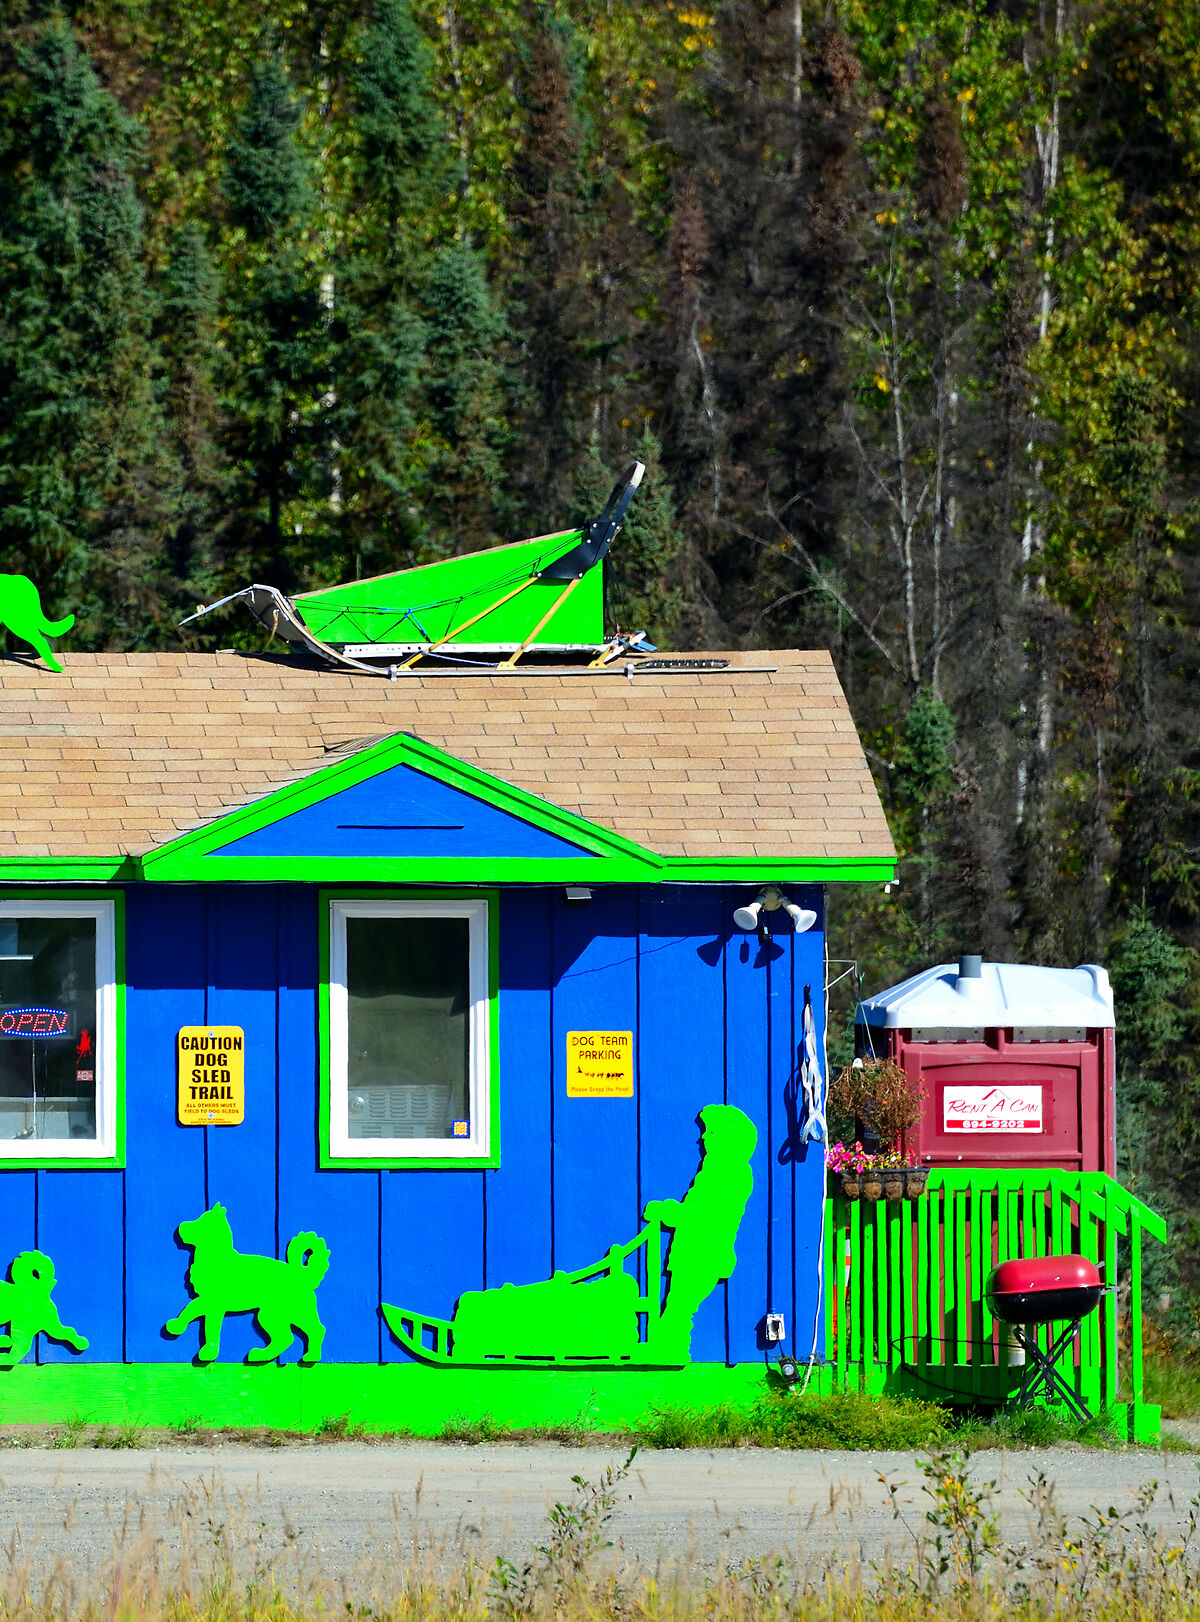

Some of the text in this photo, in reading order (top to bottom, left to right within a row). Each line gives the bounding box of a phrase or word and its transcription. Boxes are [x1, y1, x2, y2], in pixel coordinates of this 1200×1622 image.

[0, 1012, 69, 1032] OPEN
[181, 1037, 242, 1050] CAUTION
[572, 1036, 628, 1046] DOG TEAM
[195, 1053, 228, 1066] DOG
[579, 1050, 621, 1060] PARKING
[192, 1069, 230, 1083] SLED
[189, 1086, 233, 1099] TRAIL
[990, 1098, 1006, 1112] A
